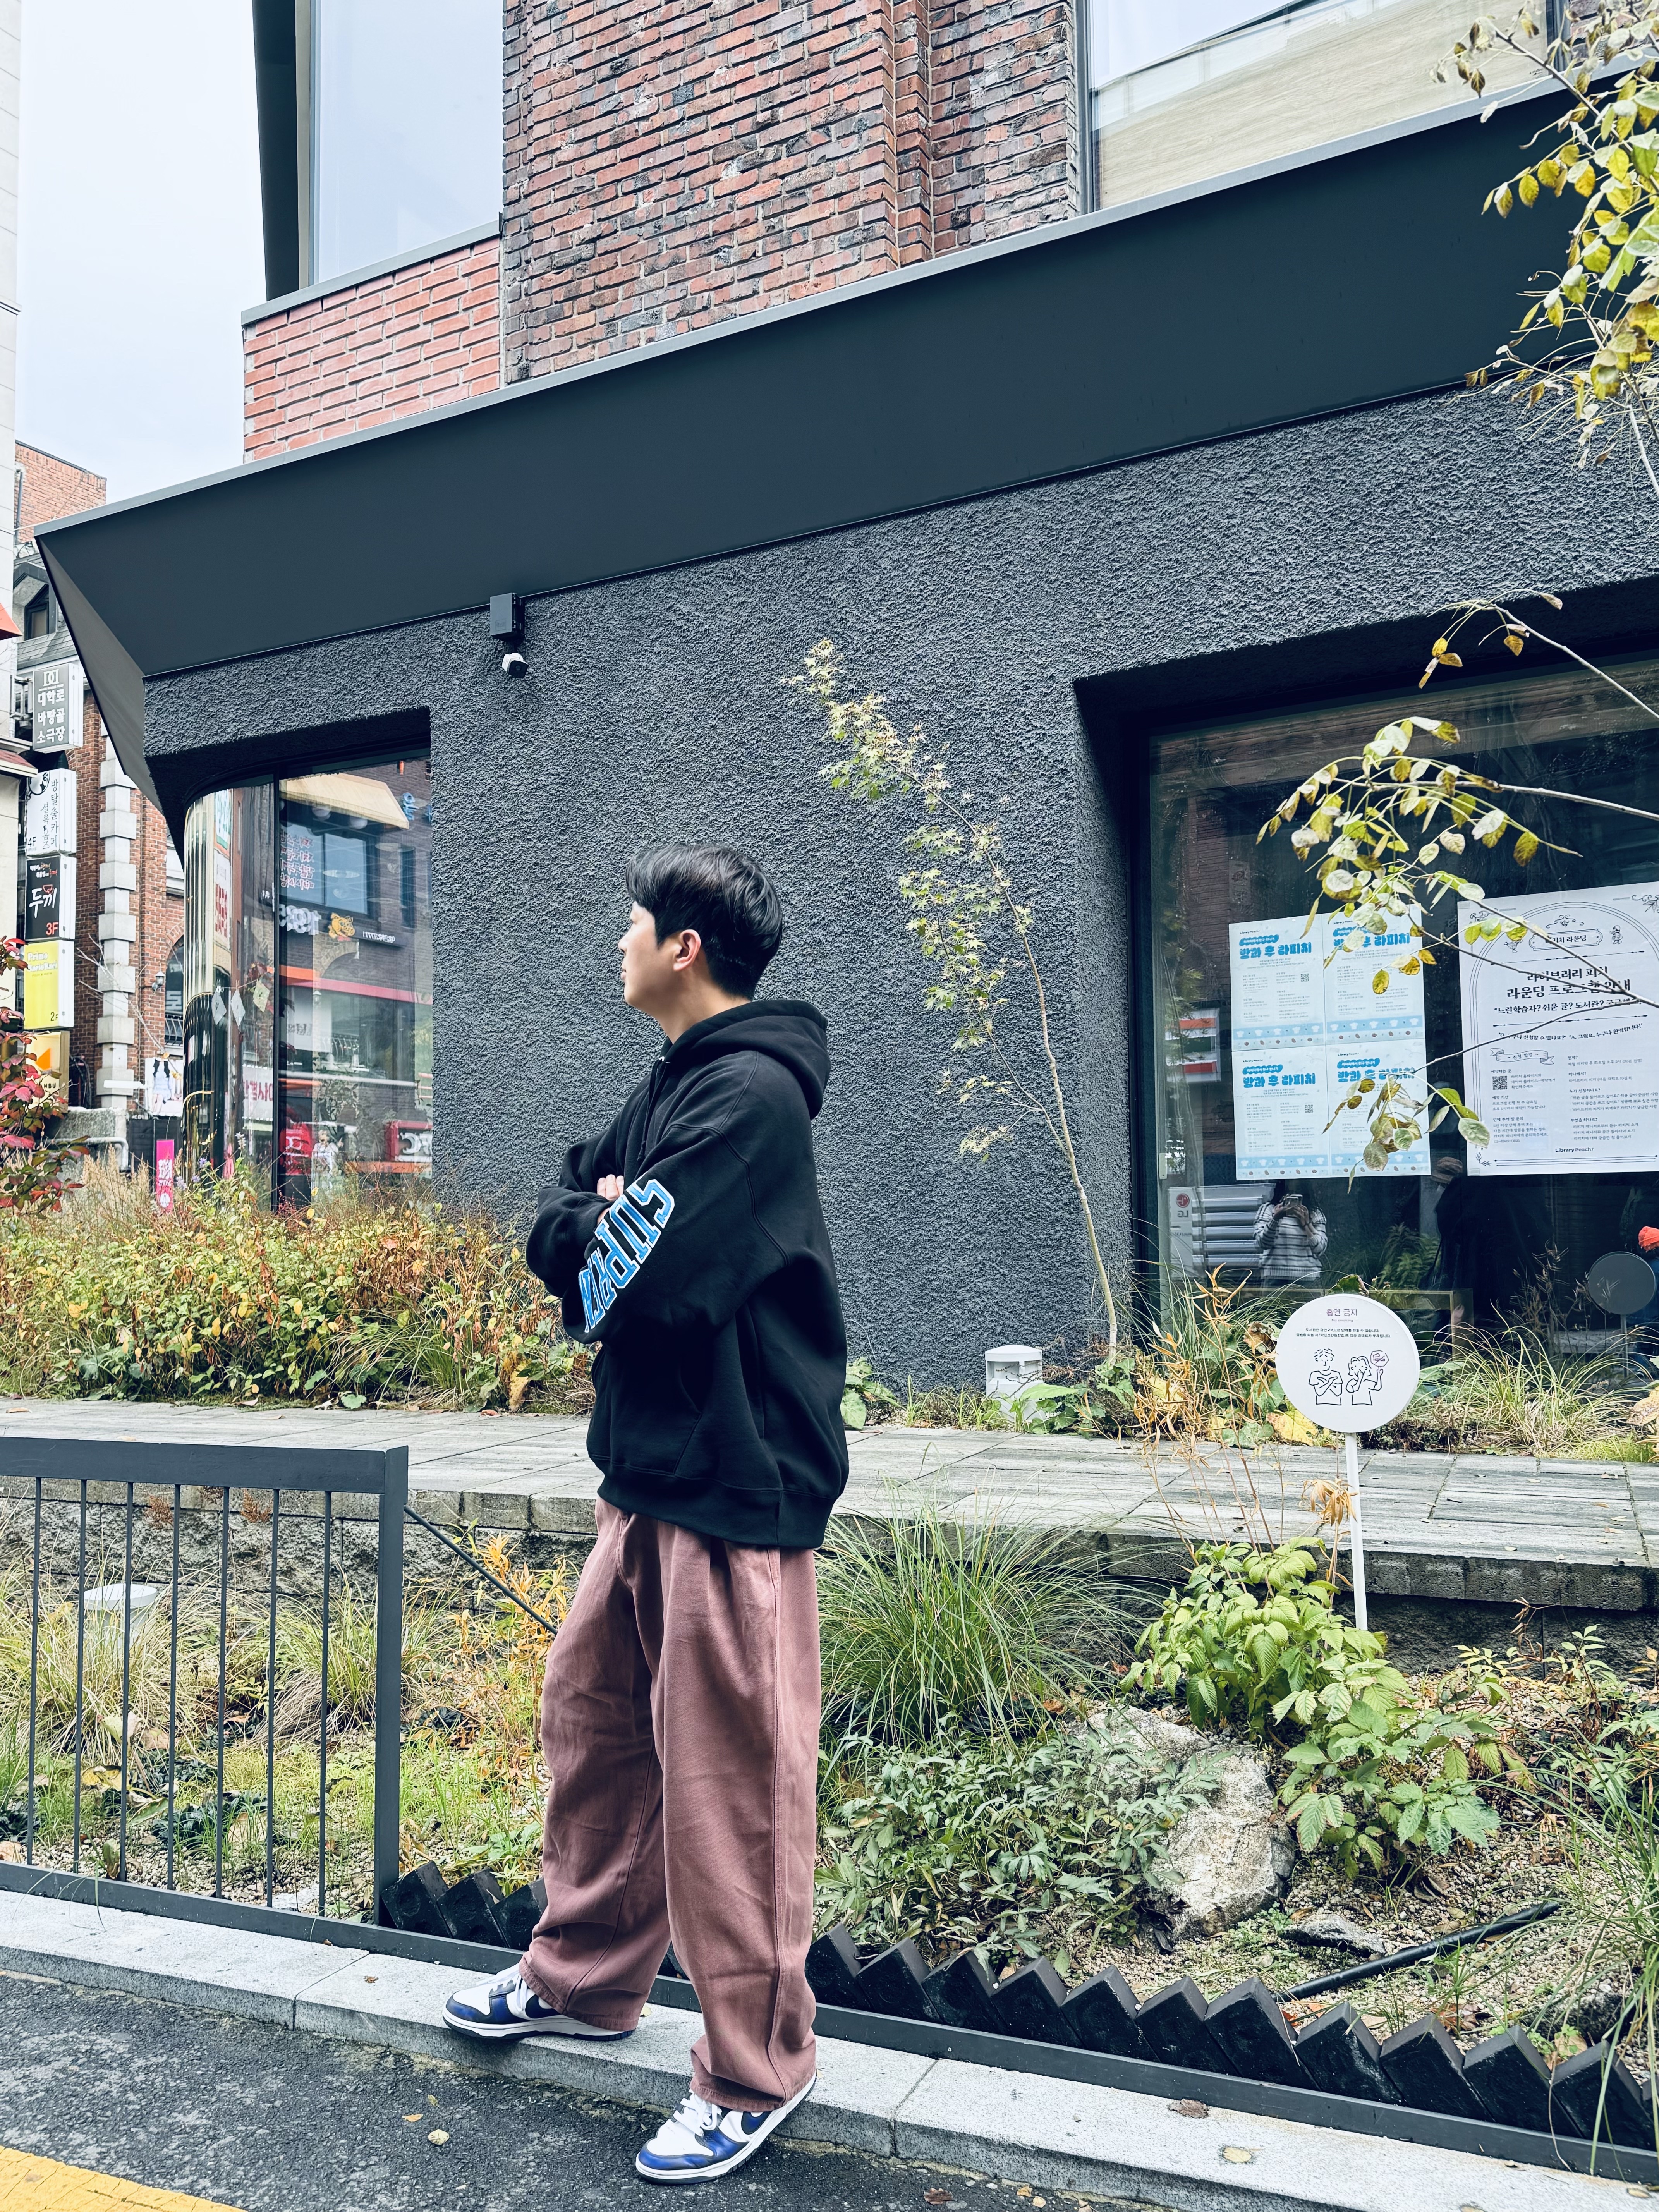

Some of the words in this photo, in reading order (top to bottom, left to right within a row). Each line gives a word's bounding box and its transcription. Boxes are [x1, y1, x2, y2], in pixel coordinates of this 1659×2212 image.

[38, 689, 65, 706] 대학로
[38, 708, 65, 726] 바탕골
[37, 726, 65, 744] 소극장
[50, 779, 59, 847] 방탈출카페
[40, 802, 50, 849] 셜록홈즈
[27, 836, 37, 847] 4F
[46, 922, 58, 936] 3F
[1374, 933, 1410, 946] 라피치
[1239, 947, 1262, 959] 방과
[1264, 945, 1275, 957] 후
[1278, 942, 1312, 955] 라피치
[1507, 986, 1545, 999] 라운딩
[1542, 1003, 1558, 1012] 쉬운
[1561, 1001, 1573, 1011] 글?
[1575, 1000, 1604, 1008] 도서관?
[1243, 1076, 1265, 1088] 방과
[1268, 1075, 1279, 1086] 후
[1282, 1073, 1316, 1085] 라피치
[1338, 1071, 1361, 1082] 방과
